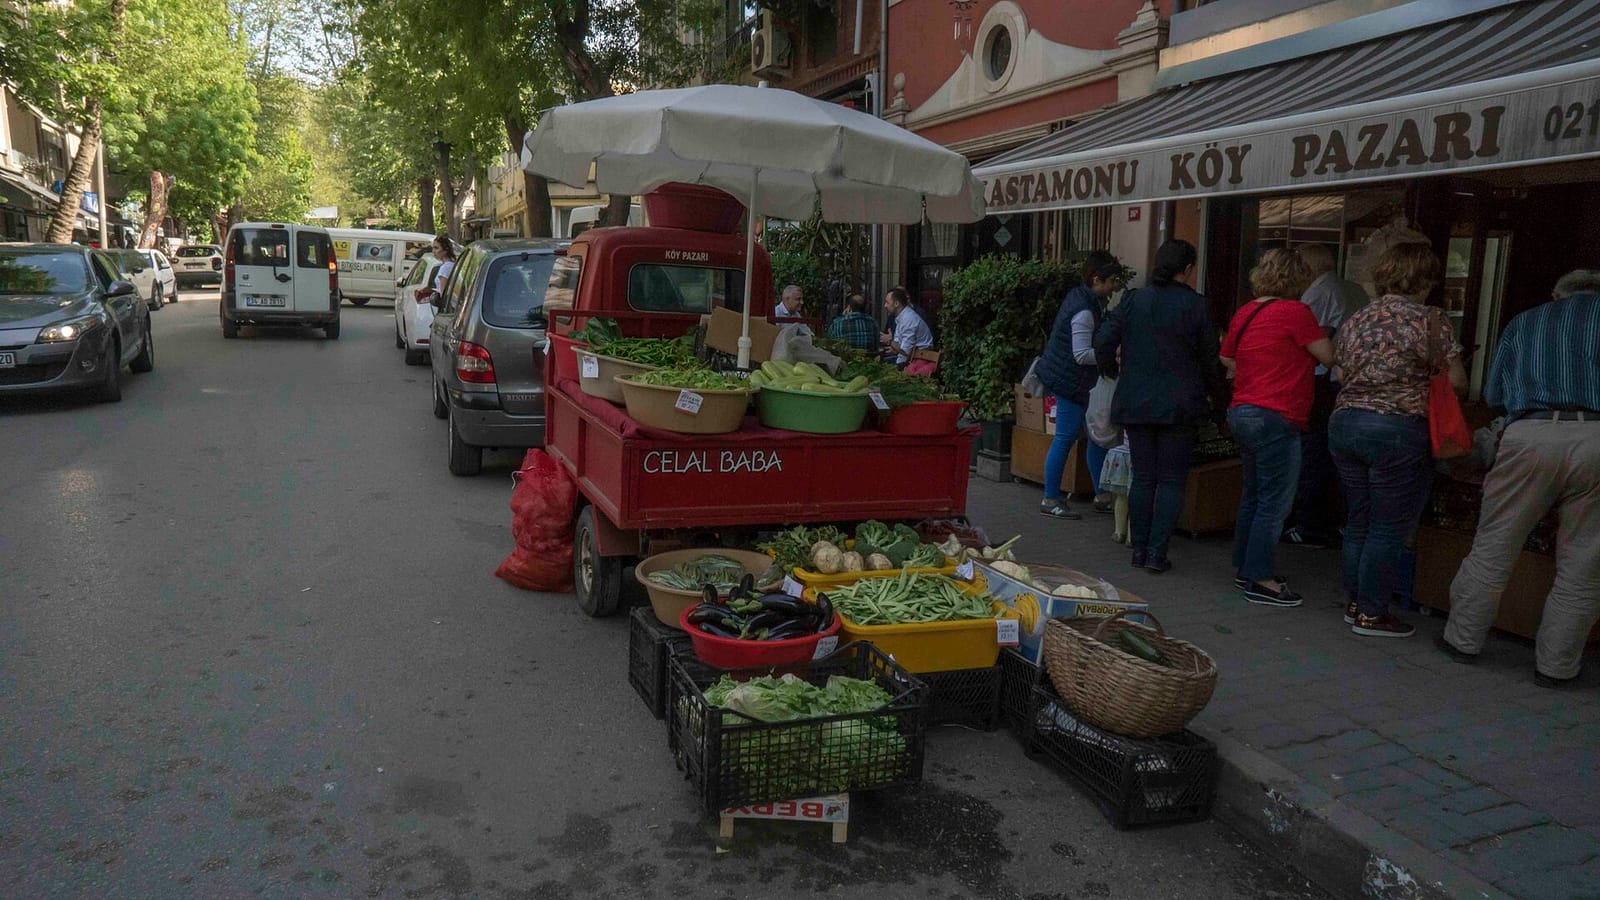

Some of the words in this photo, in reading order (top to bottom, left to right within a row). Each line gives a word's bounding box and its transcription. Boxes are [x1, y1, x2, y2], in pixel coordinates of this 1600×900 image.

[983, 158, 1140, 207] ASTAMONU
[1168, 142, 1252, 190] KÖY
[1291, 106, 1506, 178] PAZARI
[664, 249, 681, 260] KÖY
[682, 251, 709, 261] PAZARI
[643, 450, 713, 473] CELAL
[719, 450, 783, 473] BABA
